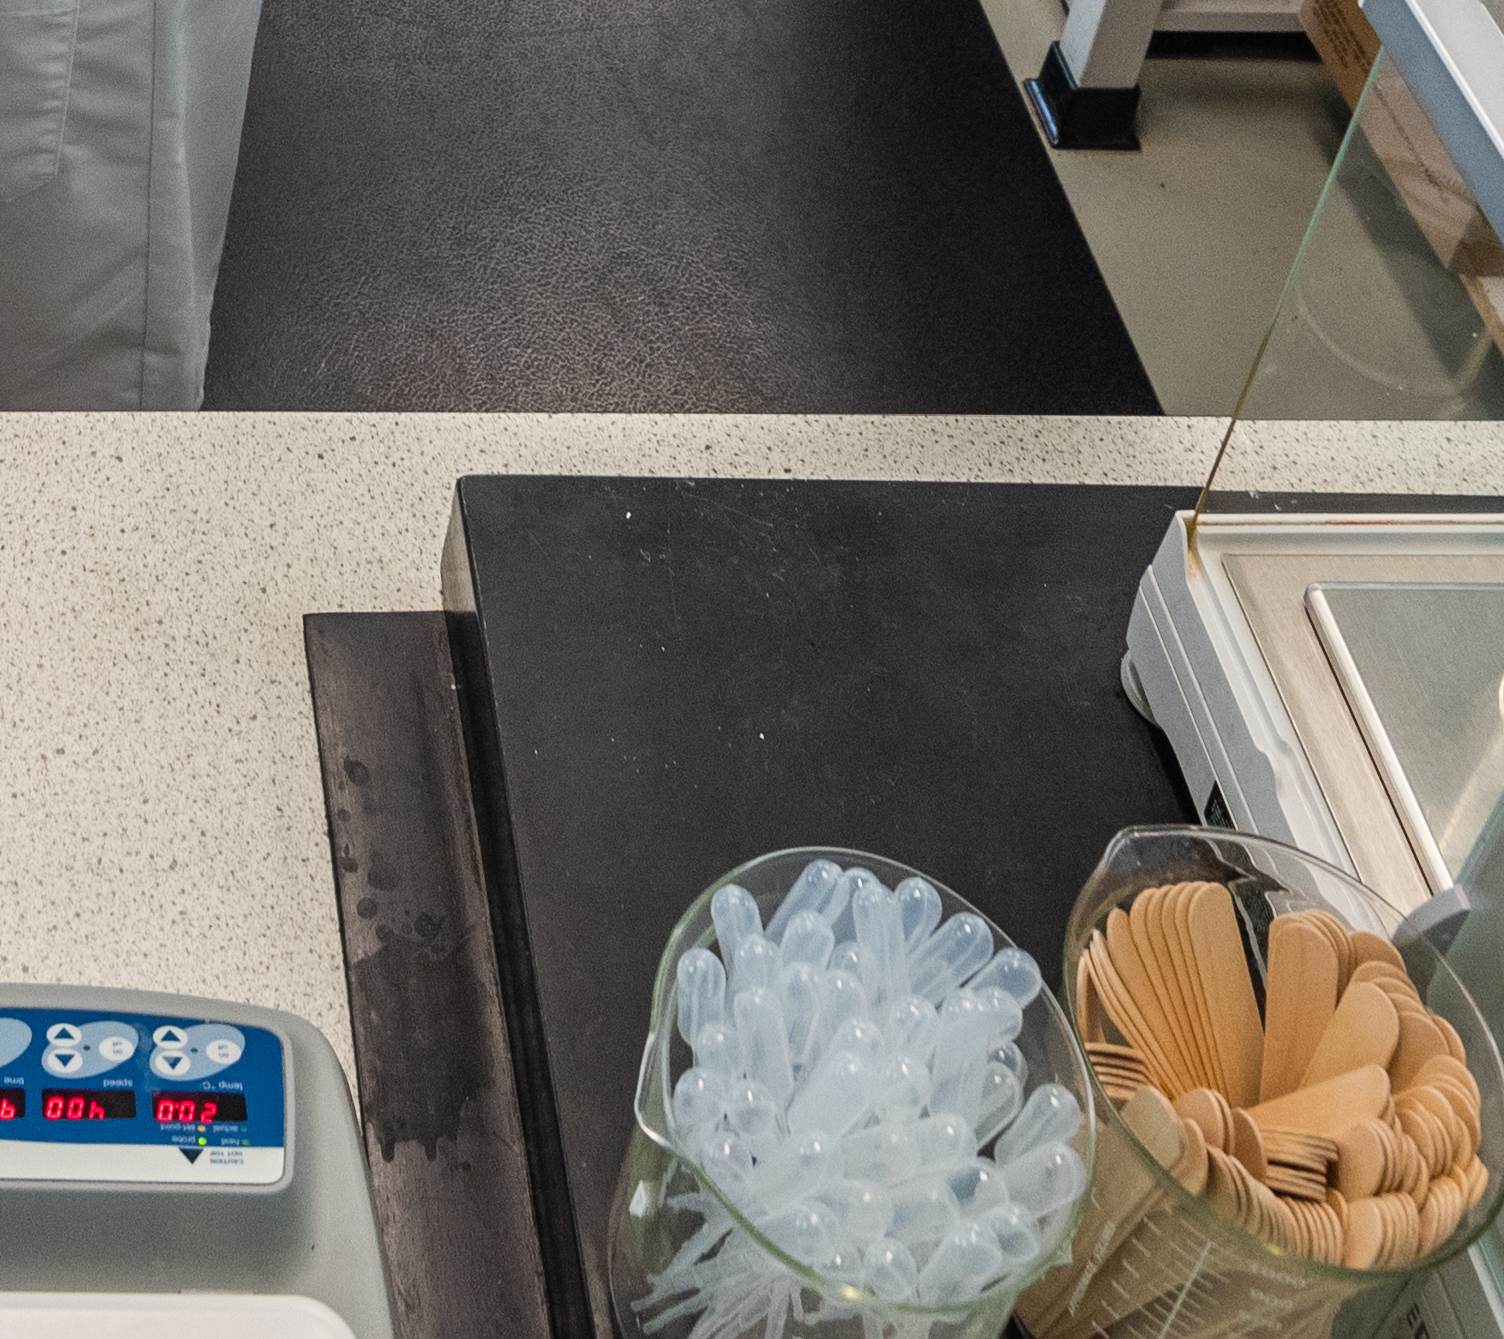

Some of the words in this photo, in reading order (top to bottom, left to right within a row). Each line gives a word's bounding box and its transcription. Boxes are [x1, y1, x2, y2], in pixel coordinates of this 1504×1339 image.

[3, 1076, 25, 1085] time
[103, 1077, 133, 1088] speed
[218, 1080, 244, 1091] temp
[45, 1097, 105, 1121] 400
[171, 1135, 196, 1144] probe
